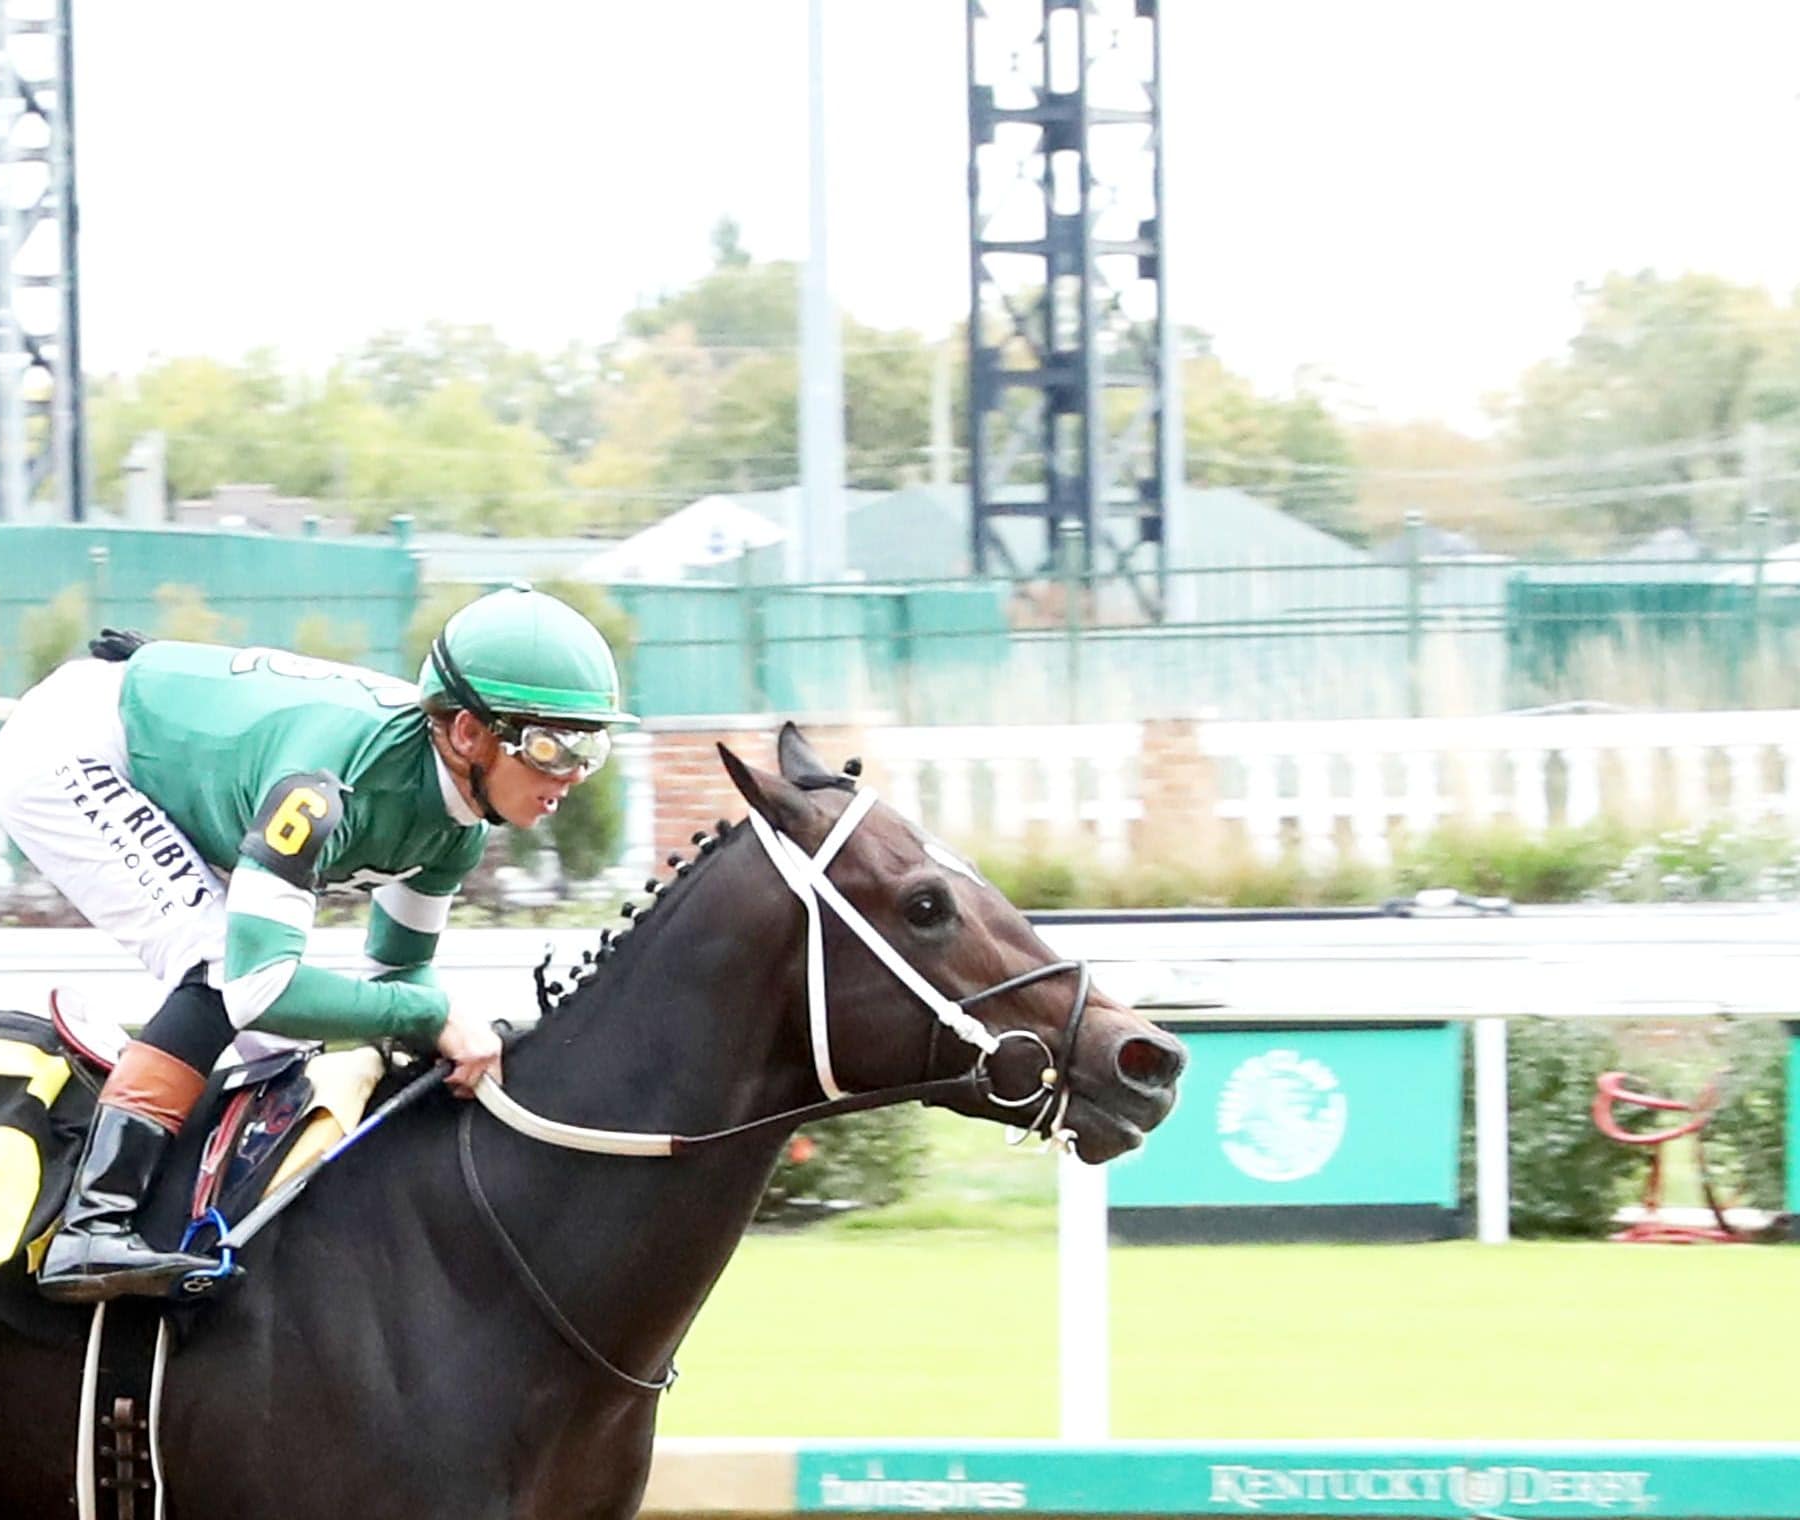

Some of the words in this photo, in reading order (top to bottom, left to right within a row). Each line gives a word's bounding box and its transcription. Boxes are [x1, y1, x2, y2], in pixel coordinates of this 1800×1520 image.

[55, 765, 175, 916] STEAKHOUSE
[123, 805, 215, 908] RUBY'S
[263, 787, 329, 857] 6
[819, 1459, 1026, 1511] twinspires
